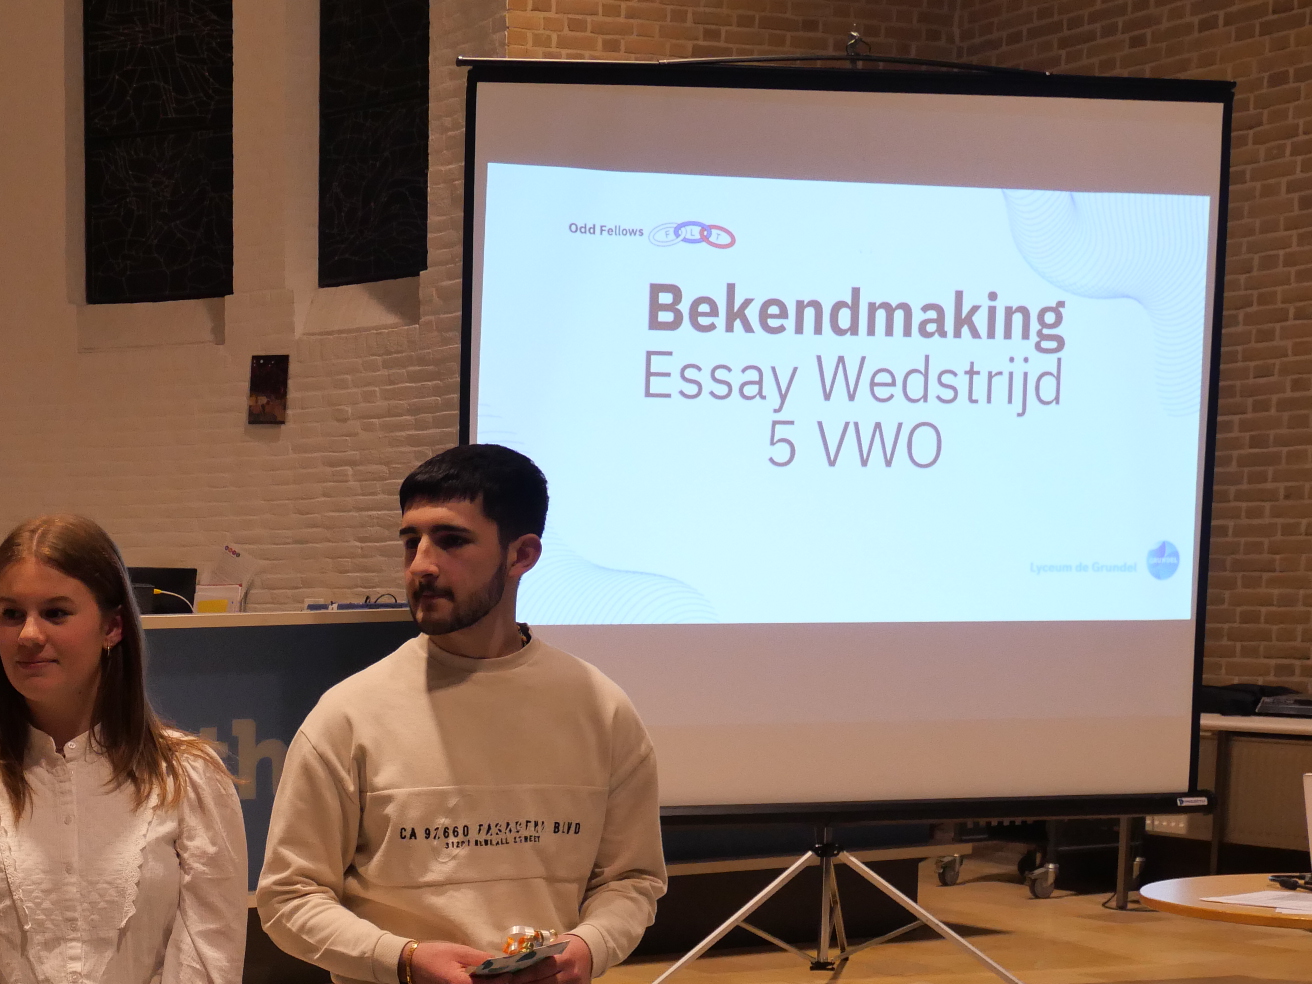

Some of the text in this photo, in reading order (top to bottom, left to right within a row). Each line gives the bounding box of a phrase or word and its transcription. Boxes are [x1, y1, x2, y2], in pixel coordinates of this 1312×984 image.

[568, 222, 644, 237] Odd Fellows
[646, 283, 1066, 354] Bekendmaking
[644, 351, 1063, 417] Essay Wedstrijd
[768, 420, 944, 469] 5 VWO
[1030, 562, 1137, 575] Lyceum de Grundel
[399, 827, 418, 840] CA
